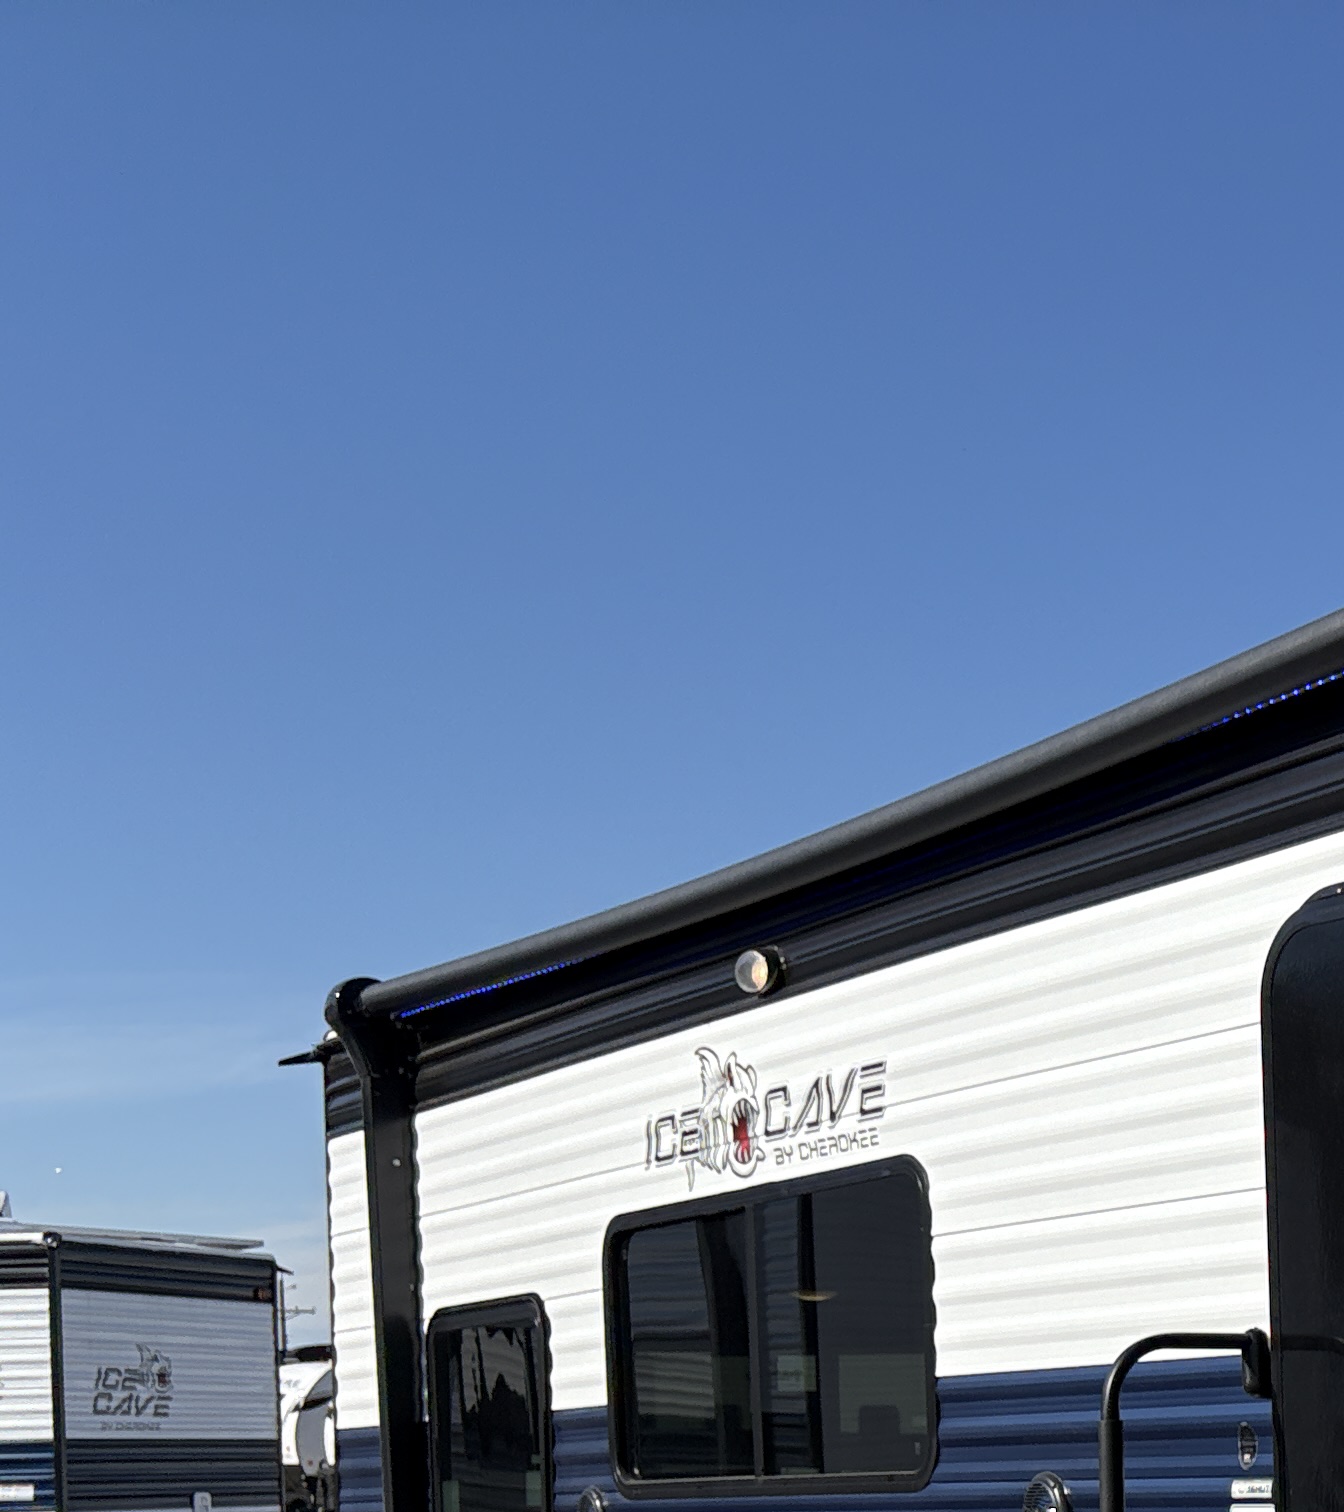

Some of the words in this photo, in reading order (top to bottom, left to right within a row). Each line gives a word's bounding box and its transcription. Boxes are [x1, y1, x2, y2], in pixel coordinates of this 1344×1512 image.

[644, 1107, 701, 1170] ICE
[764, 1060, 887, 1141] CAVE
[774, 1148, 793, 1166] BY
[799, 1127, 880, 1160] CHEROKEE
[95, 1367, 144, 1391] ICE
[92, 1392, 173, 1417] CAVE
